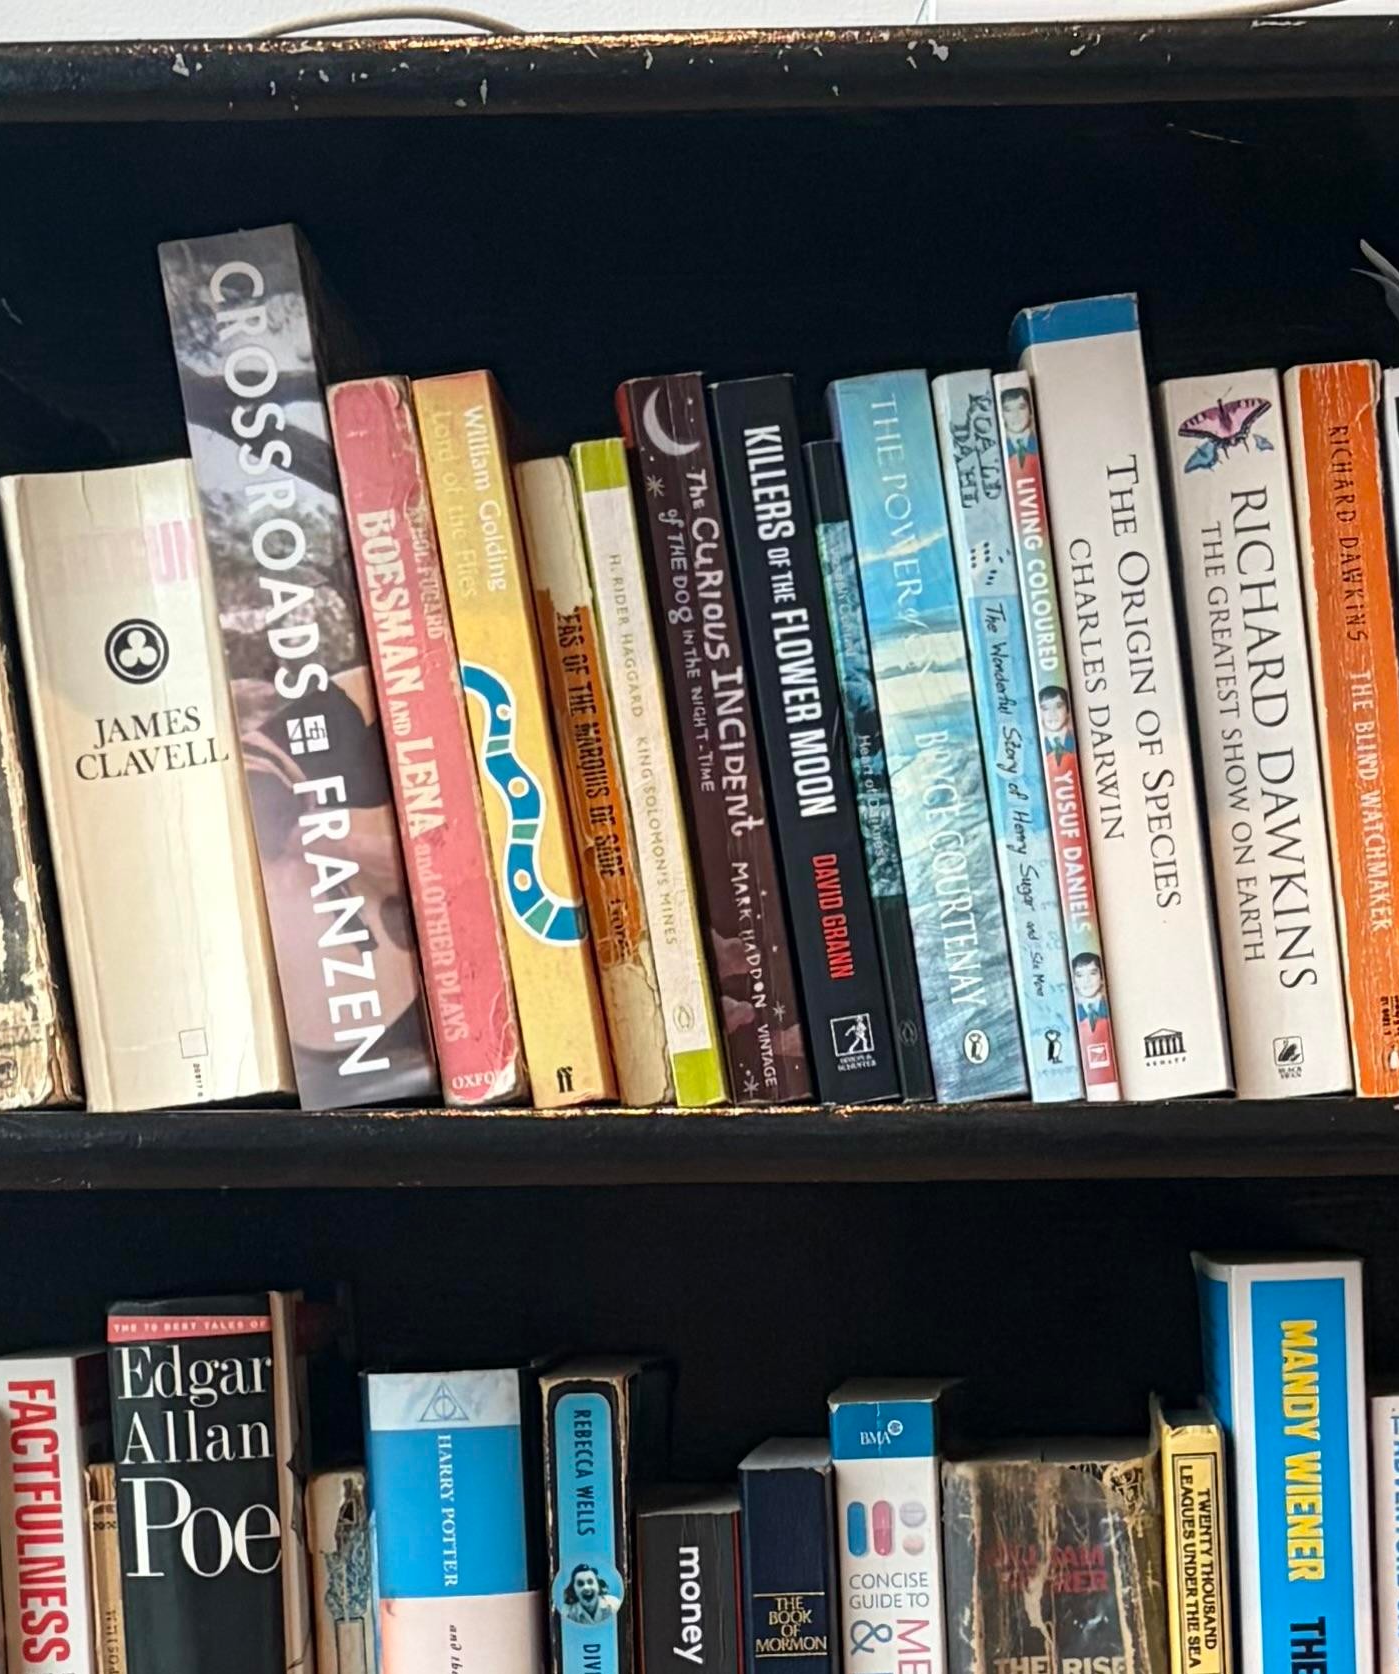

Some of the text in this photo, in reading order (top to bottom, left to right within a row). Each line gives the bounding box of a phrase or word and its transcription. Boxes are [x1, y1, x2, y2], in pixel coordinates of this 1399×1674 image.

[465, 407, 508, 591] William Golding
[1015, 477, 1059, 672] LIVING COLOURED
[93, 706, 201, 749] JAMES
[210, 261, 390, 1076] CROSSROADS FRANZEN
[1068, 539, 1126, 842] CHARLES DARWIN
[76, 738, 229, 781] CLAVELL
[117, 1346, 270, 1407] Edgar
[121, 1411, 271, 1465] Allan
[574, 1409, 595, 1536] REBECCA WELLS
[1280, 1320, 1325, 1582] MANDY WIENER
[8, 1379, 70, 1664] FACTFULNESS
[122, 1478, 281, 1578] Poe
[438, 1435, 459, 1587] HARRY POTTER
[673, 1547, 703, 1664] money
[849, 1573, 928, 1589] CONCISE
[755, 1636, 827, 1653] MORMON
